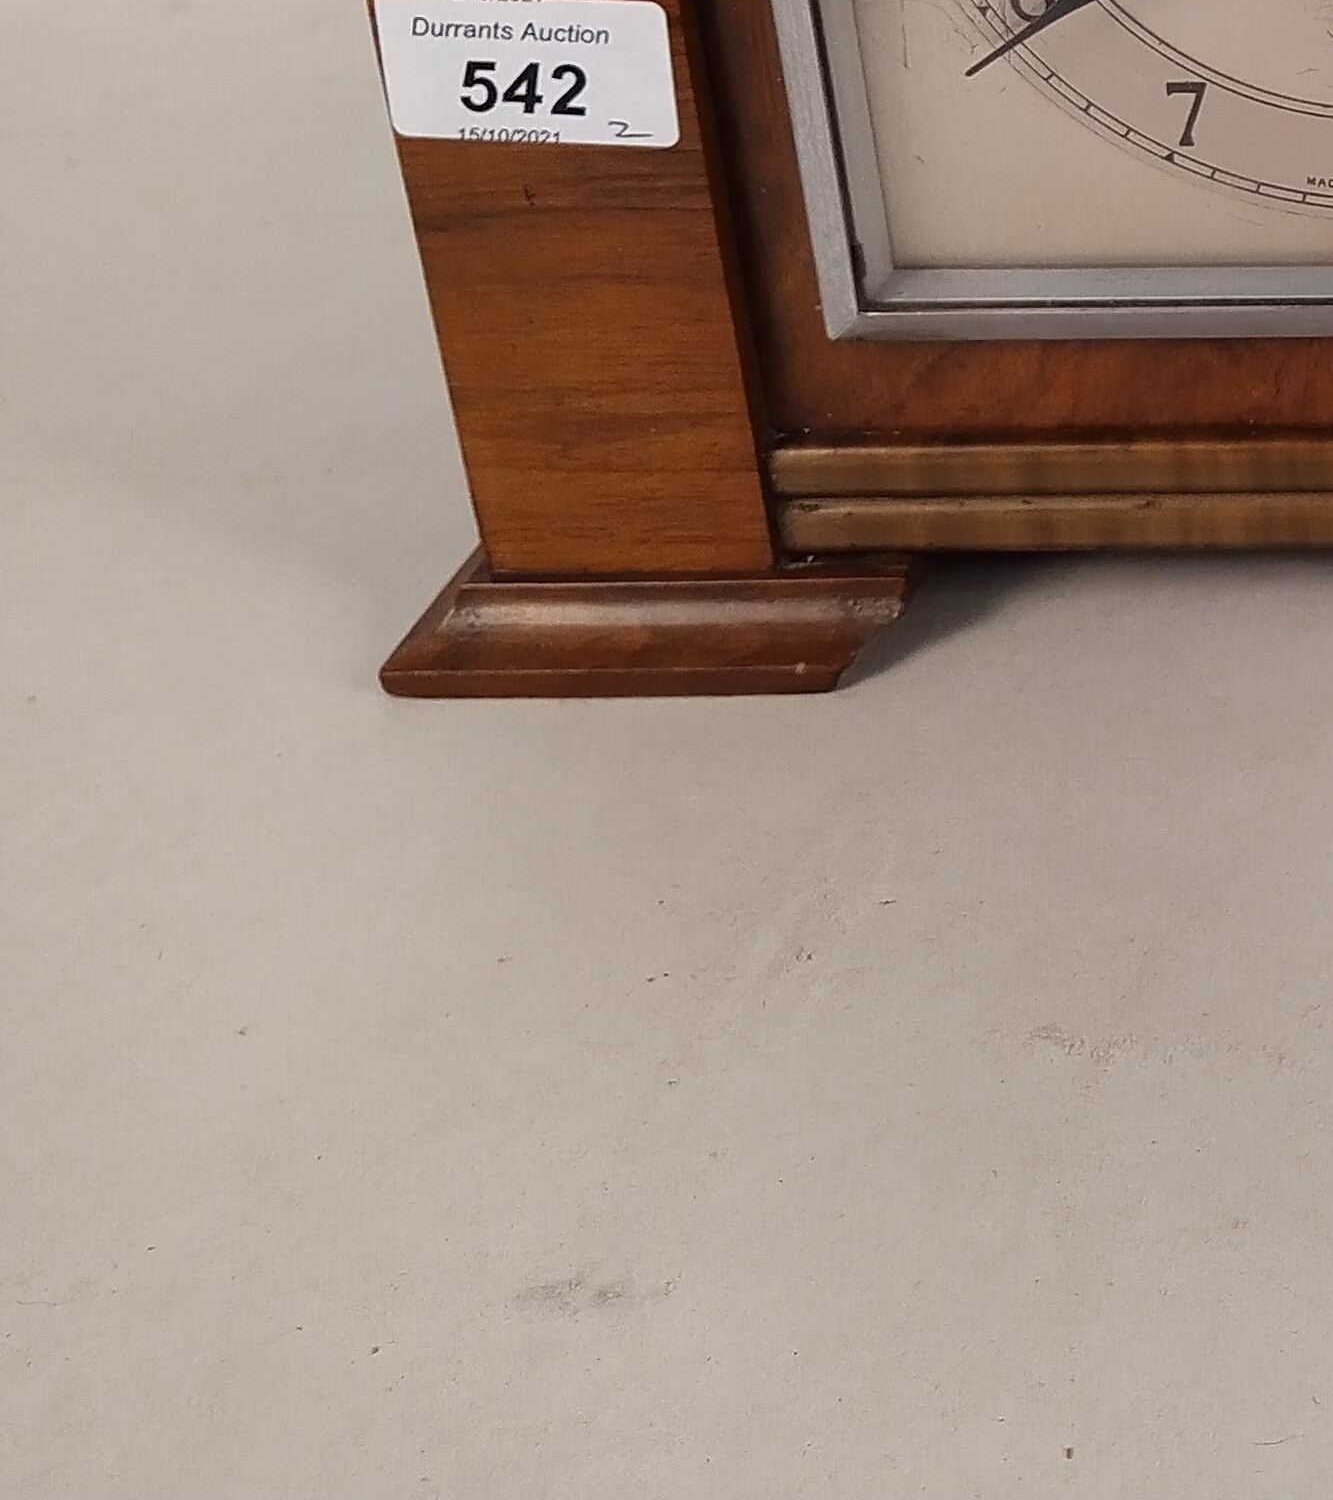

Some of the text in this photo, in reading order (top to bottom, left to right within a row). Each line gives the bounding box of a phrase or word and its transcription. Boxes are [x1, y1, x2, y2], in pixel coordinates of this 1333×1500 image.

[412, 17, 609, 45] Durrants Auction
[460, 60, 587, 116] 542
[458, 126, 562, 144] 15/10/2021
[1167, 82, 1207, 146] 7
